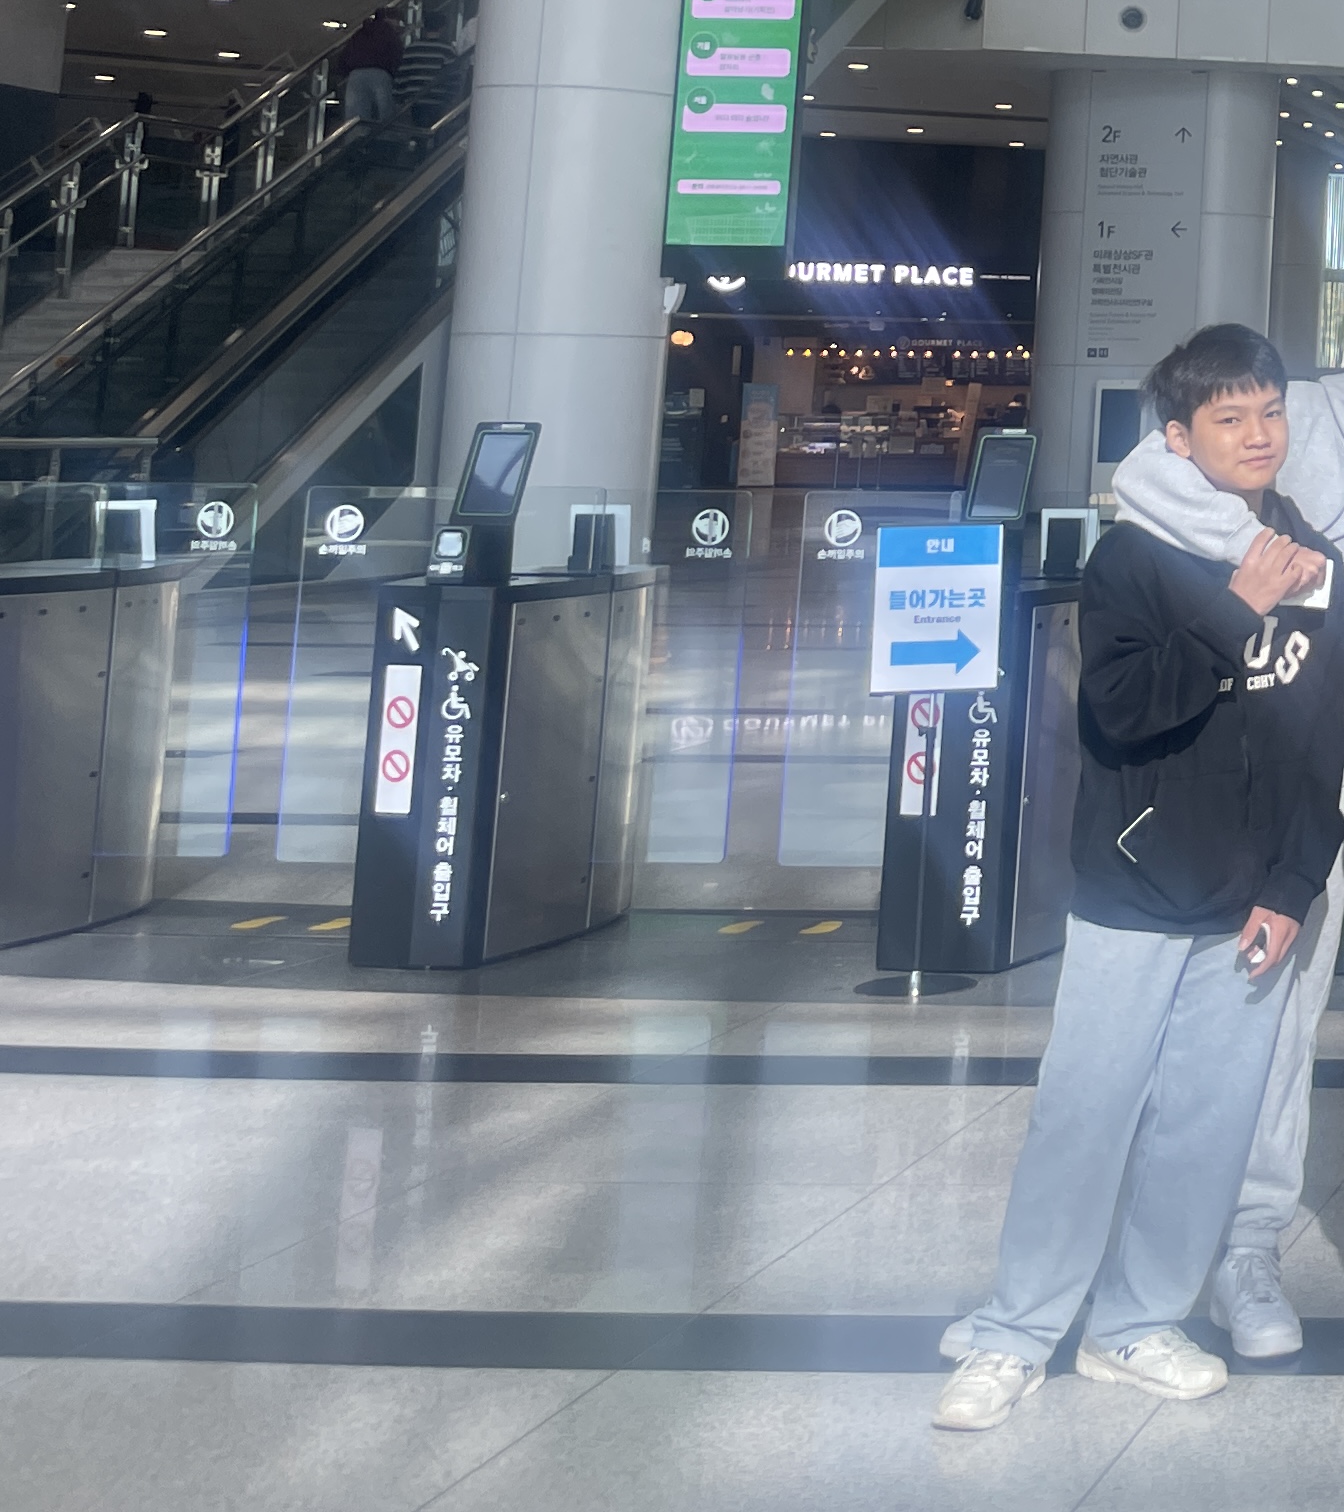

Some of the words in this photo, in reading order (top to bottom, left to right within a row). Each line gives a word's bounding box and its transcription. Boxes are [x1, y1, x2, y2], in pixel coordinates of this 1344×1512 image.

[1102, 125, 1122, 143] 2F
[1098, 221, 1116, 239] 1F
[788, 262, 886, 283] URMET
[894, 265, 974, 286] PLACE
[926, 538, 955, 554] 안내
[913, 615, 961, 624] Entrance
[429, 861, 454, 924] 출입구
[960, 864, 983, 926] 출입구
